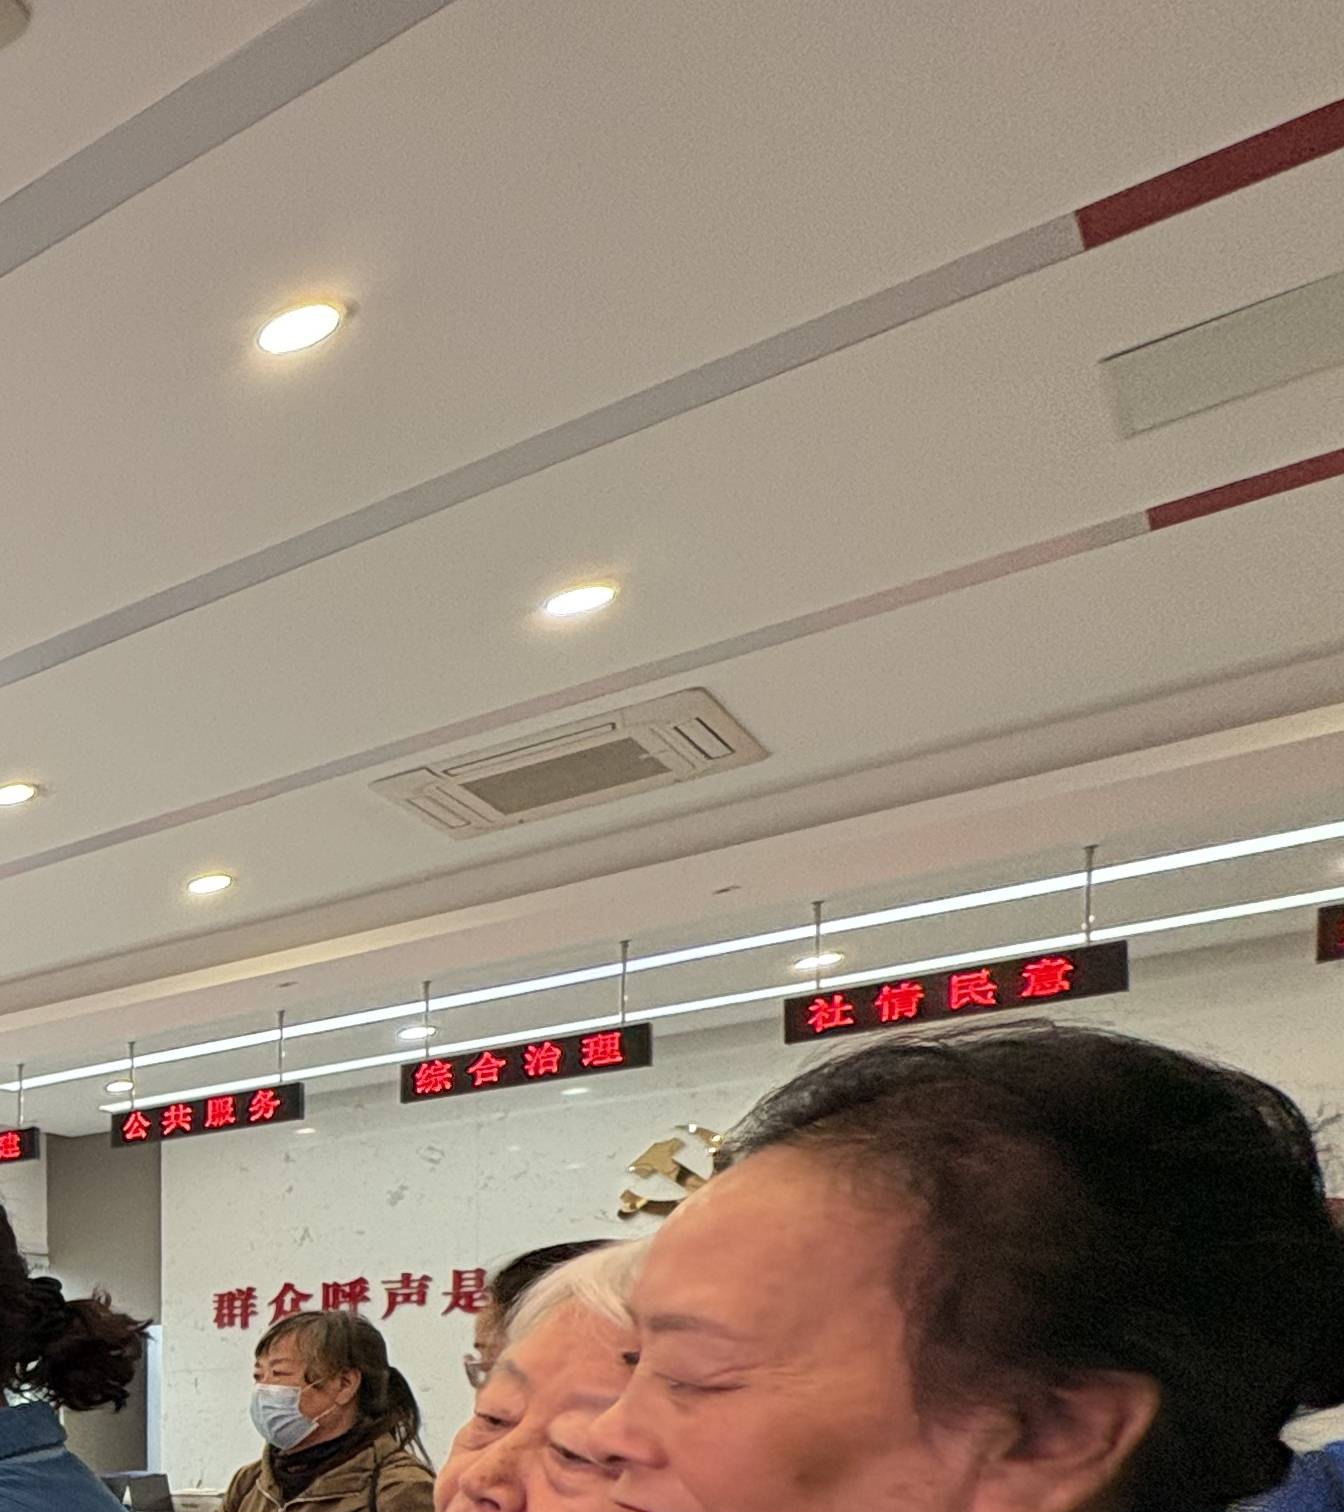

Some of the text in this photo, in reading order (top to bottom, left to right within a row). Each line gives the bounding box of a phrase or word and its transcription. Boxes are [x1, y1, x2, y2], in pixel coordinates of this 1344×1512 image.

[412, 1031, 626, 1097] 综合治理
[120, 1088, 283, 1142] 公共服务
[212, 1267, 487, 1330] 群众呼声是
